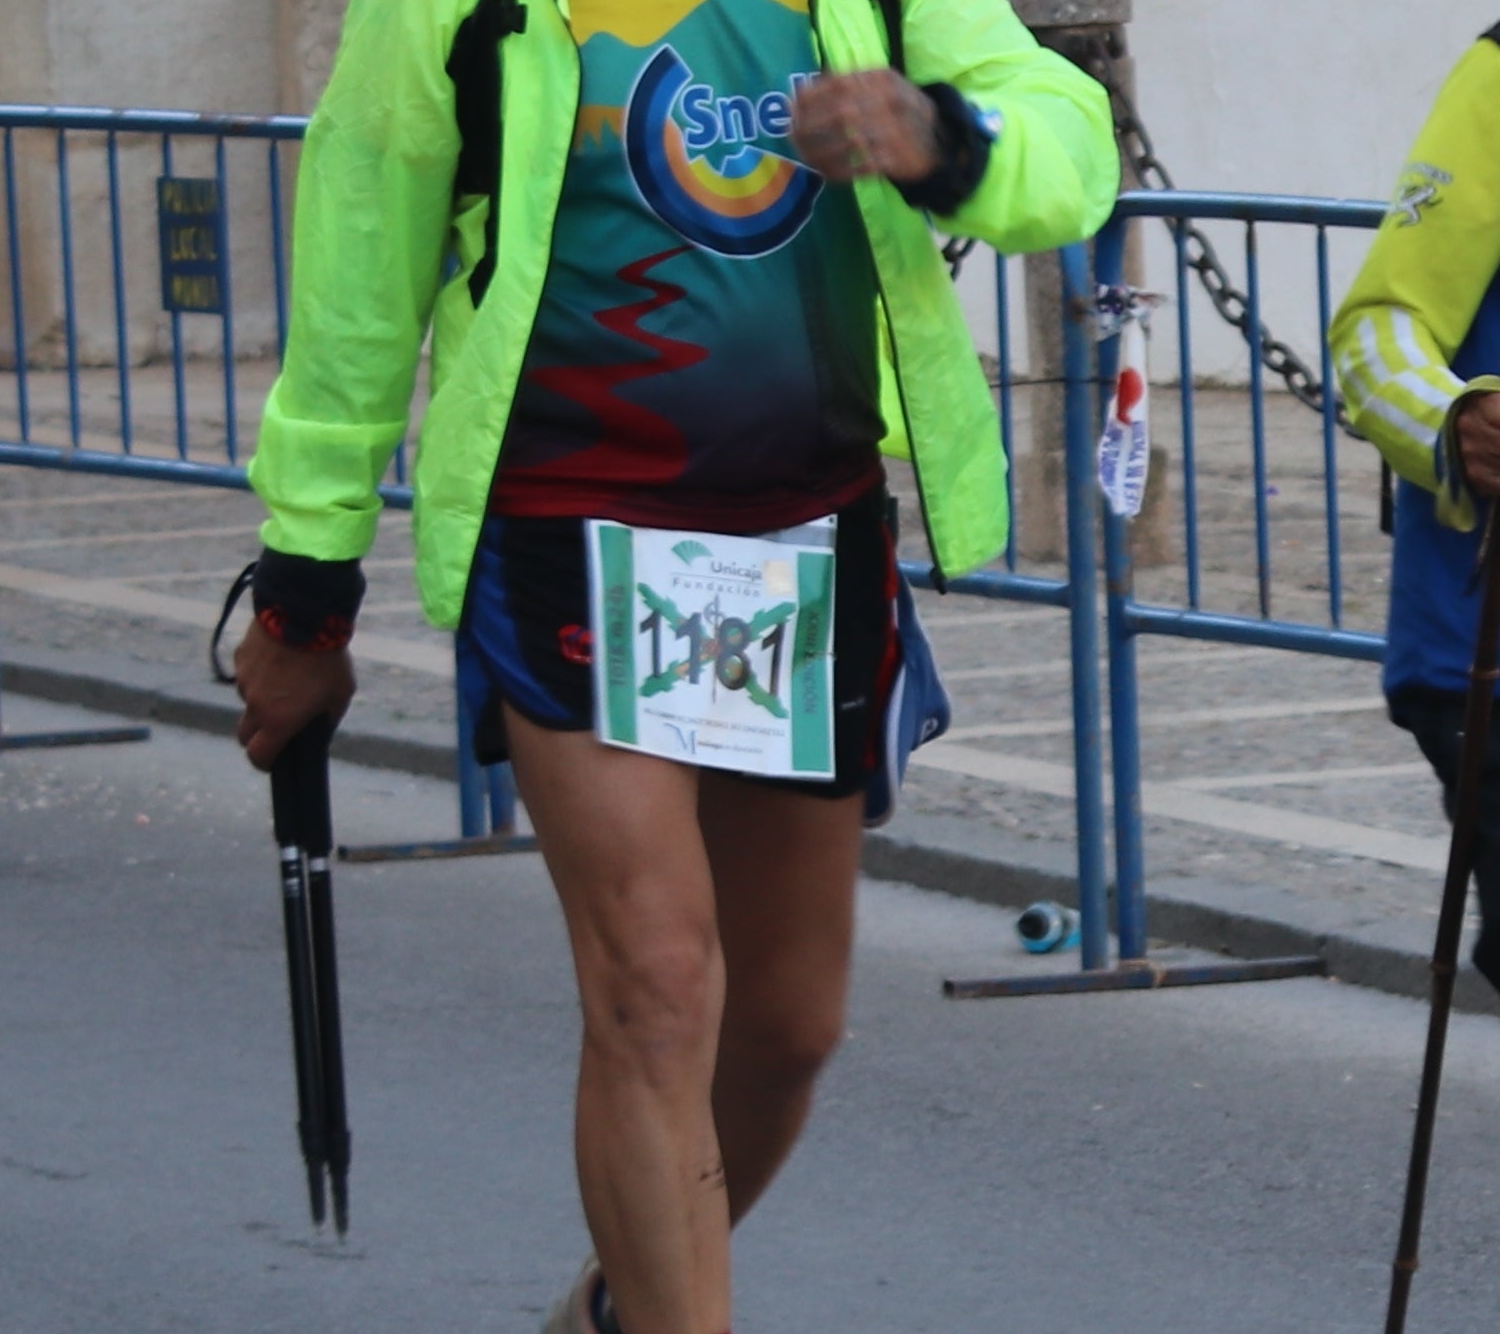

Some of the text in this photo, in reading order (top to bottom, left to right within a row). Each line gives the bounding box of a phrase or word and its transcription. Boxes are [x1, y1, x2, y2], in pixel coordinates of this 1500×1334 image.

[680, 72, 821, 149] Sne
[673, 577, 761, 597] Fundación
[711, 561, 763, 582] Unicaja
[640, 608, 786, 697] 1181
